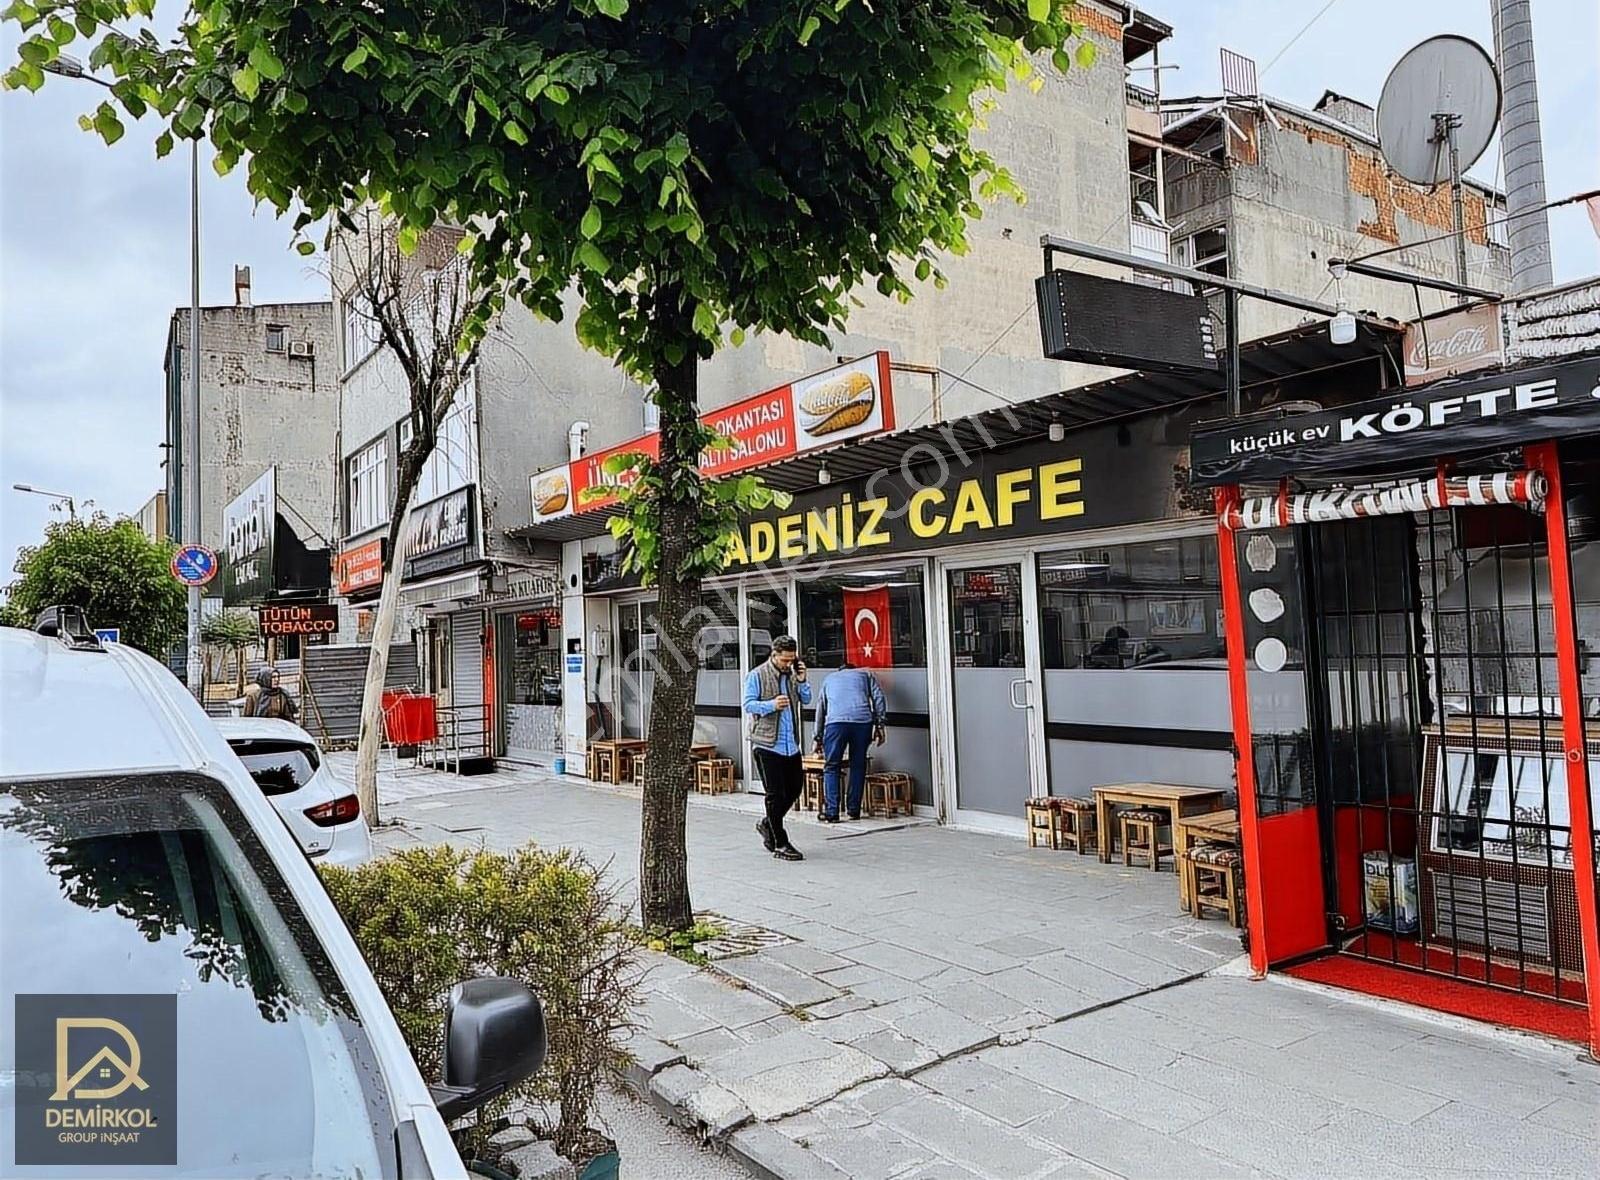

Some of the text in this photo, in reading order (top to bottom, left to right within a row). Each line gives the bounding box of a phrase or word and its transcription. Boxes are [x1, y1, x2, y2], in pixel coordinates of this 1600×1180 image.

[714, 398, 784, 436] OKANTASI
[1230, 379, 1558, 454] küçük ev KÖFTE
[698, 427, 786, 471] ALTI SALONU
[723, 458, 1085, 568] ADENİZ CAFE
[260, 606, 311, 621] TÜTÜN
[260, 620, 335, 634] TOBACCO
